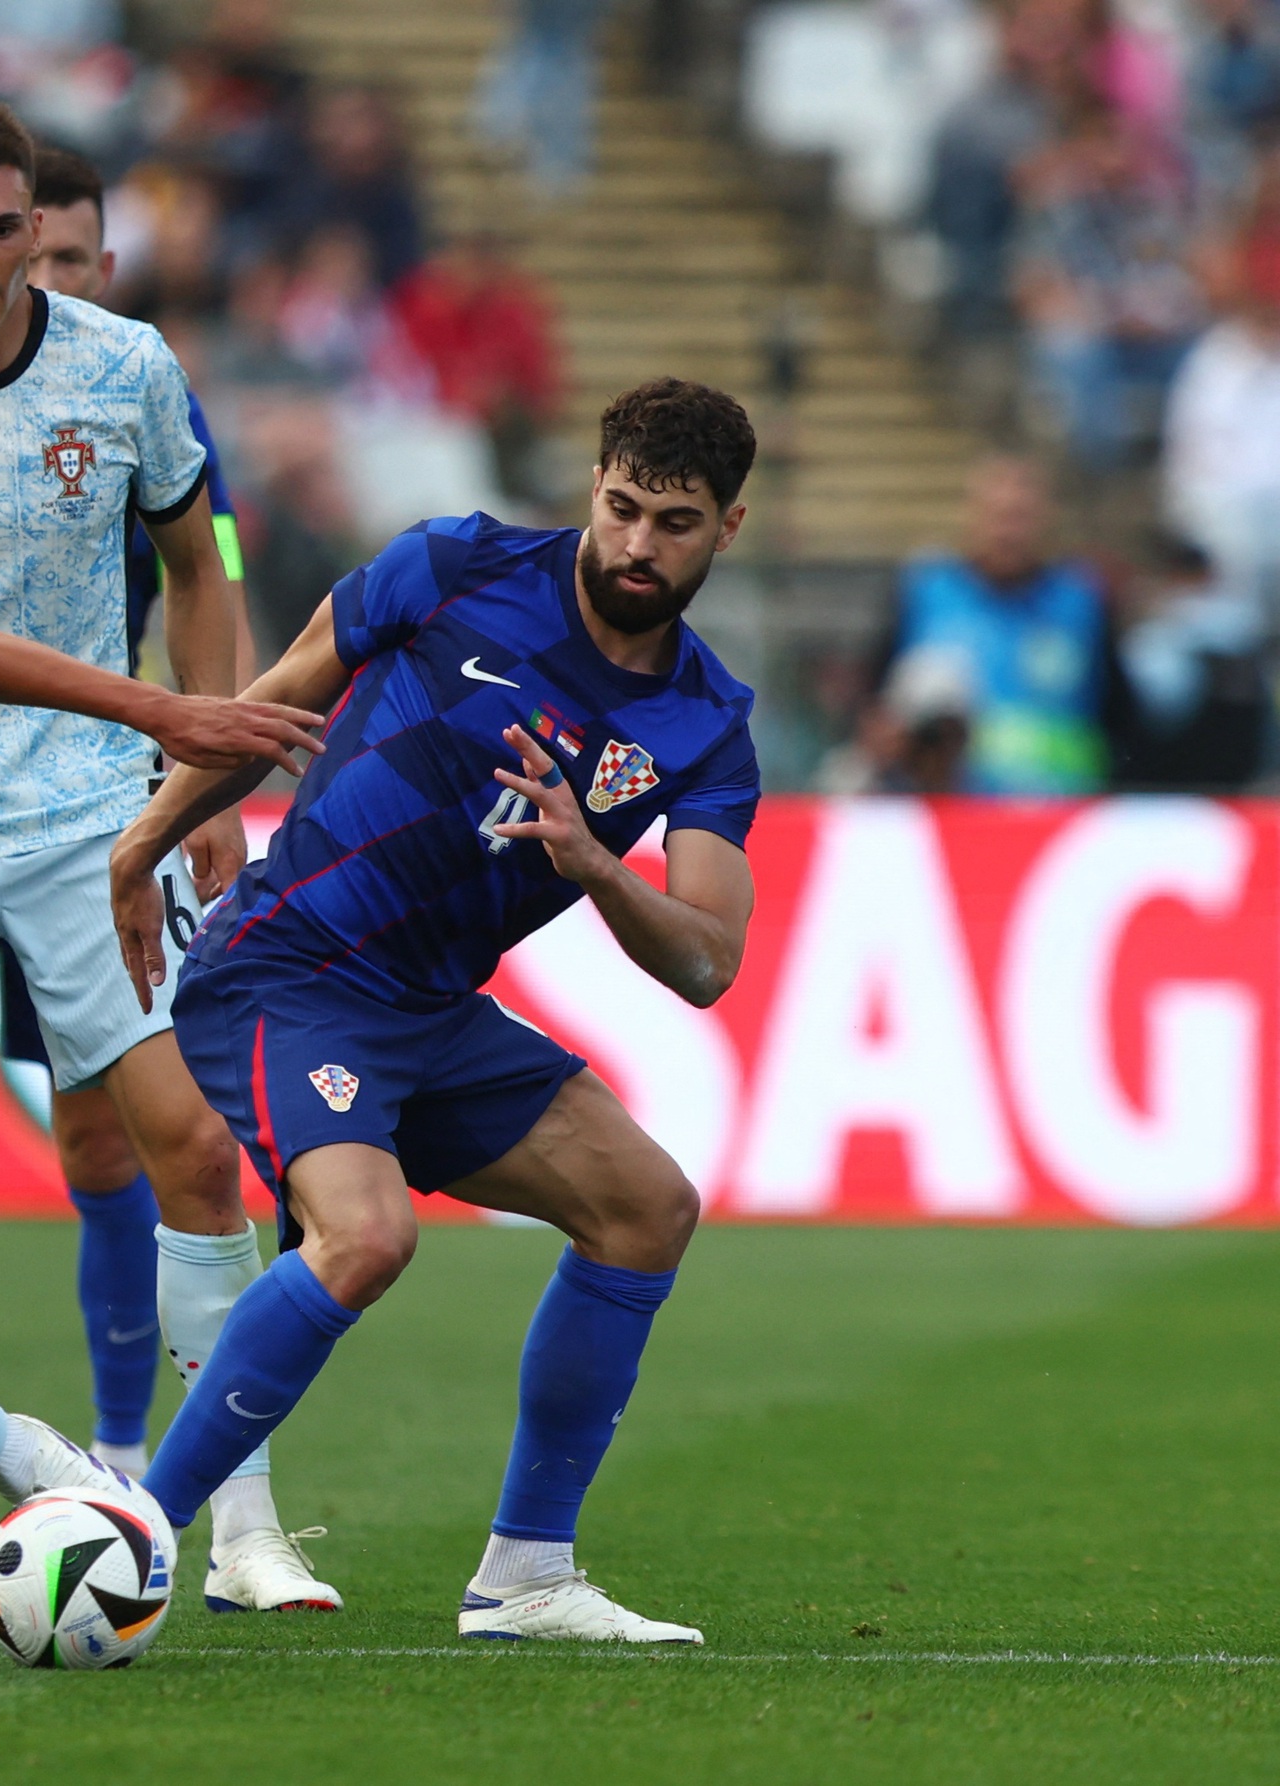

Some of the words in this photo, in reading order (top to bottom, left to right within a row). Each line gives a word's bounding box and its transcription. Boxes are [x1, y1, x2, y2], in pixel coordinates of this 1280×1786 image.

[478, 787, 530, 855] 4
[161, 874, 197, 952] 6
[524, 1600, 550, 1613] COPA
